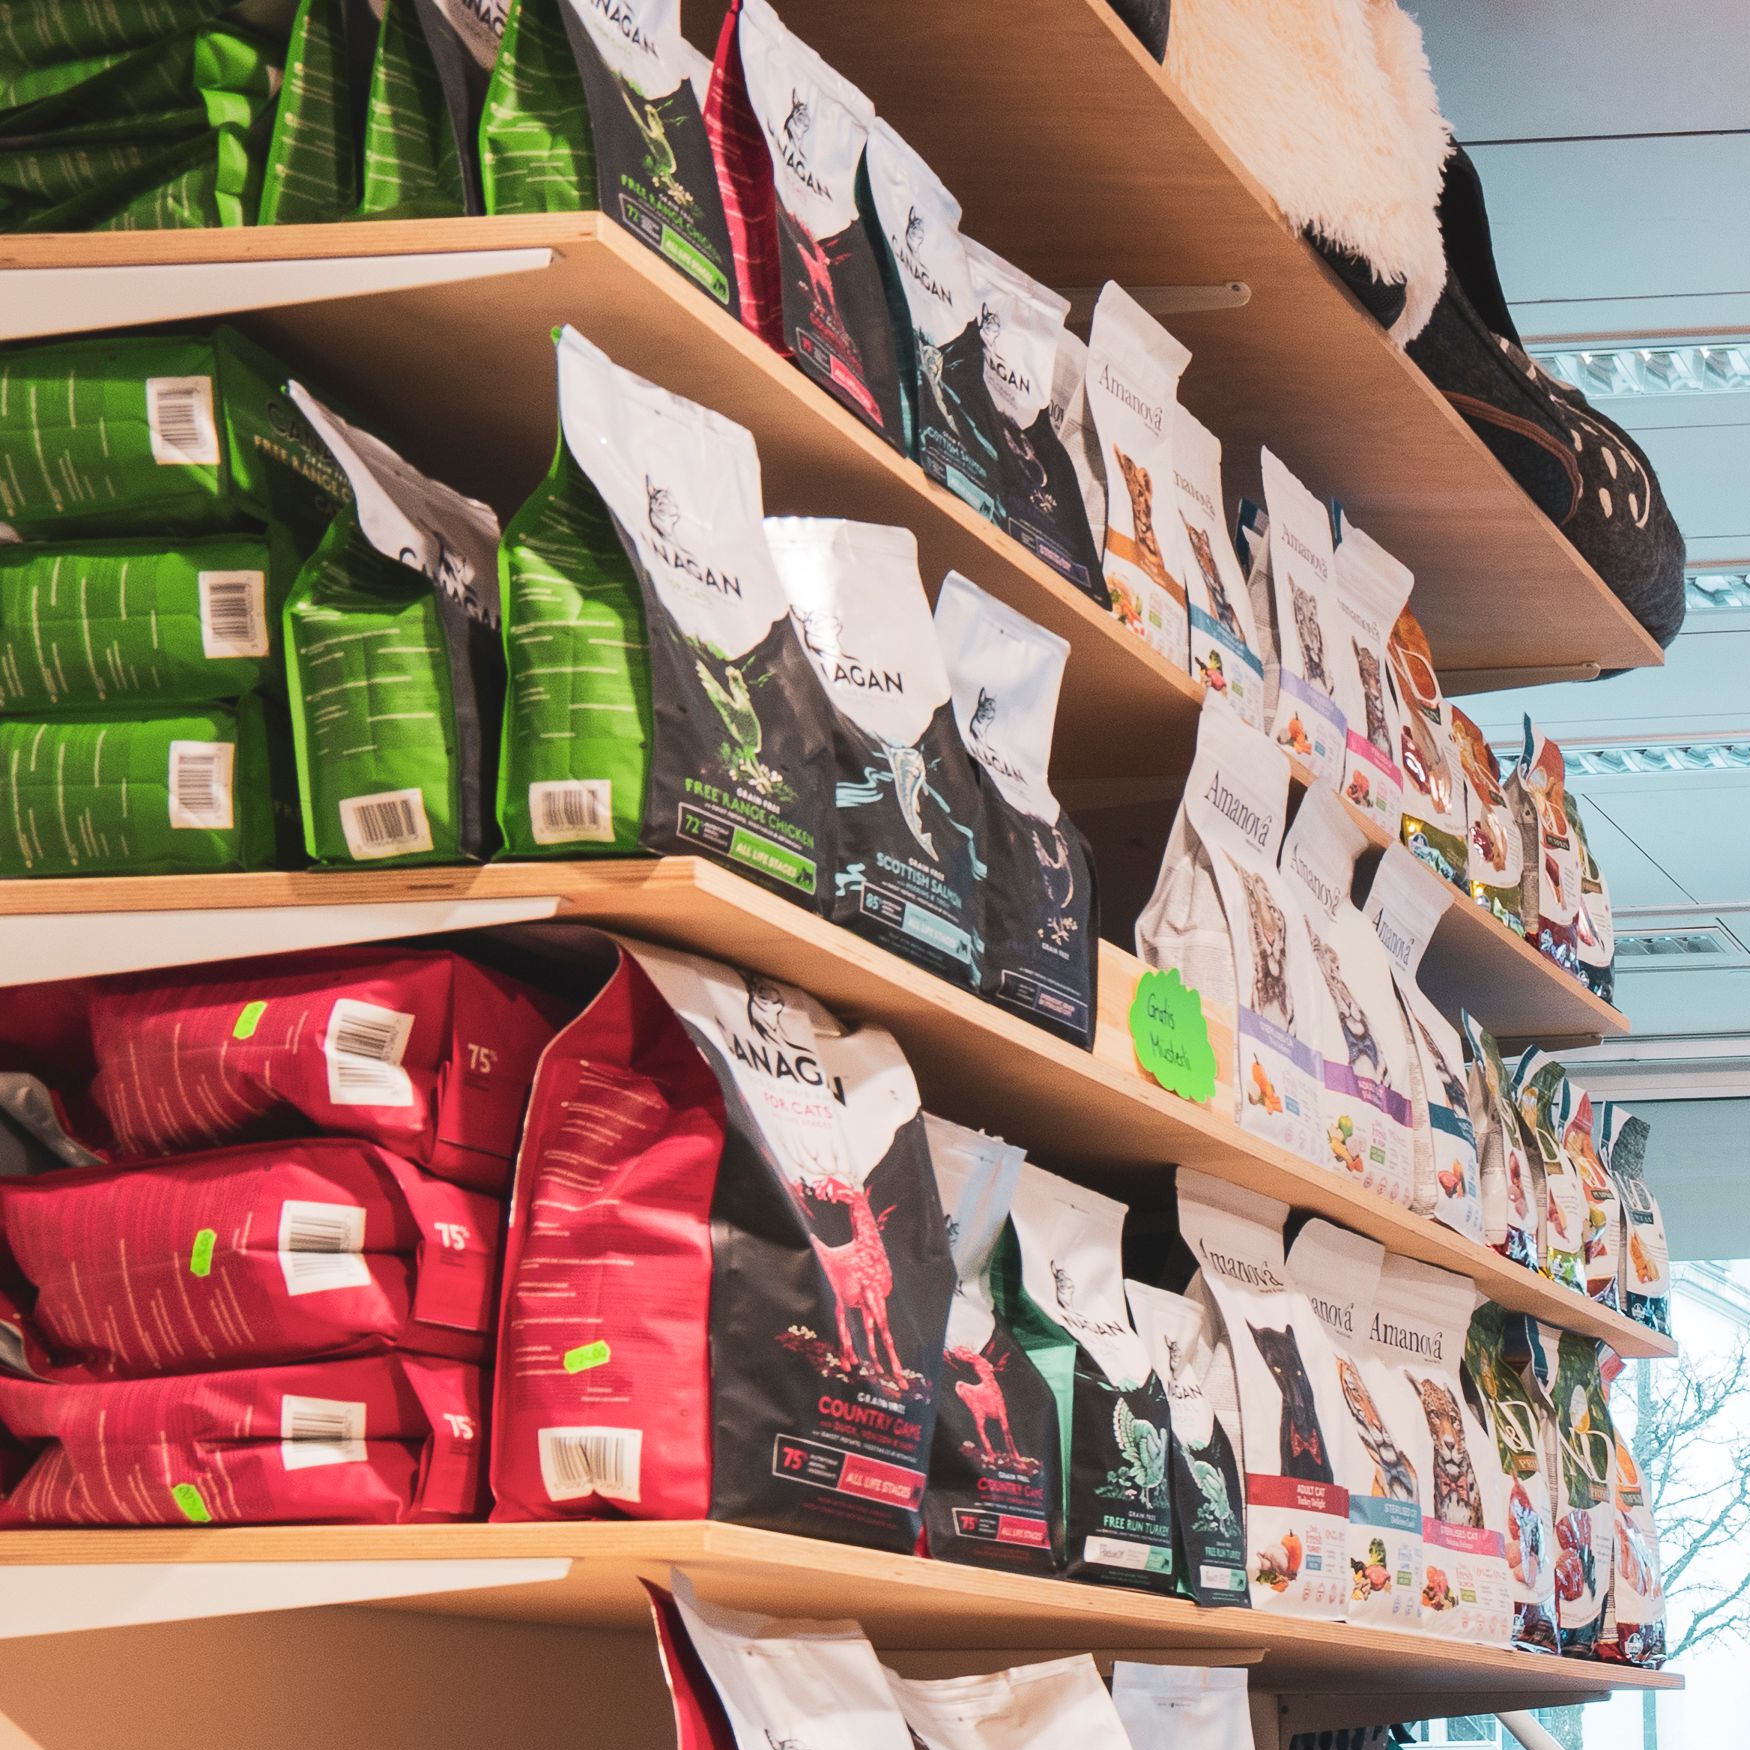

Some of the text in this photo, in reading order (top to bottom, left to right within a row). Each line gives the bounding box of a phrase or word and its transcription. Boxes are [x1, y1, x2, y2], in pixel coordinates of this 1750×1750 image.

[794, 1099, 835, 1122] CATS
[1368, 1311, 1443, 1362] Amanová
[818, 1395, 895, 1433] COUNTRY
